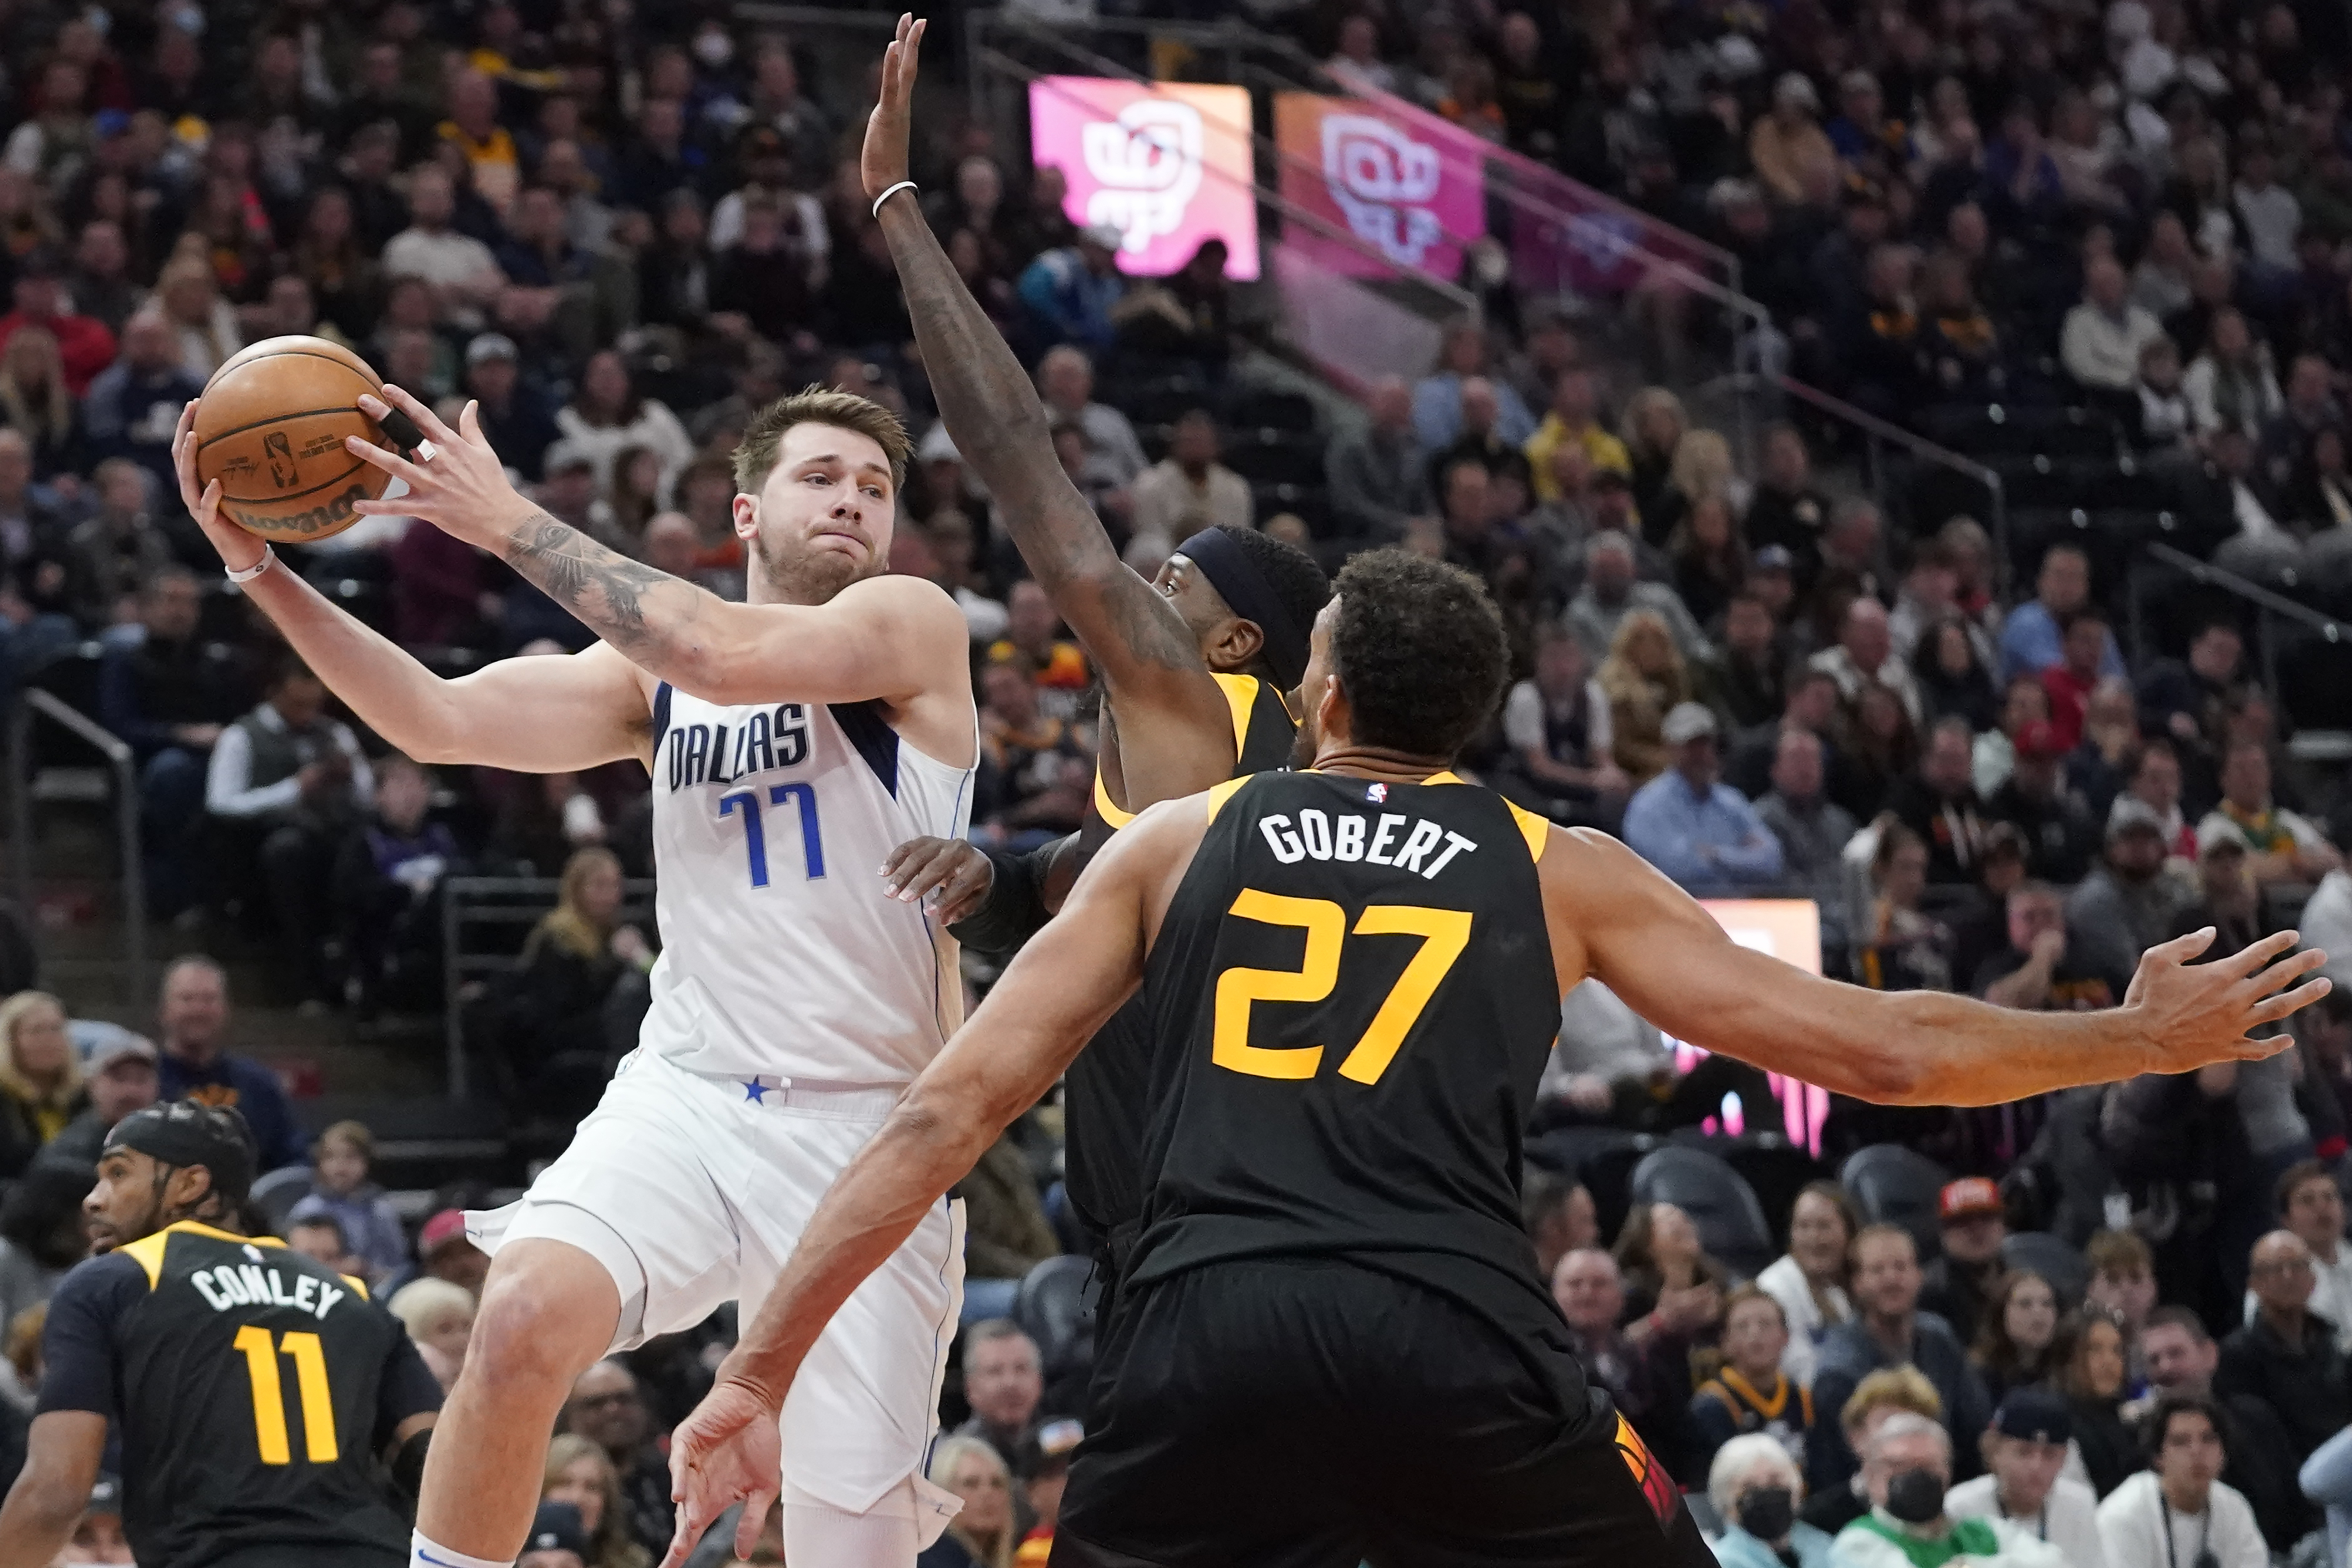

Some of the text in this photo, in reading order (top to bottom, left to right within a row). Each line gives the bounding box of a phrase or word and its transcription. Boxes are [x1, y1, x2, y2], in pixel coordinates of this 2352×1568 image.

[670, 703, 809, 796] DALLAS
[718, 781, 827, 889] 77
[1258, 808, 1478, 880] GOBERT
[1212, 887, 1473, 1085] 27
[191, 1264, 345, 1321] CONLEY
[233, 1324, 338, 1465] 11
